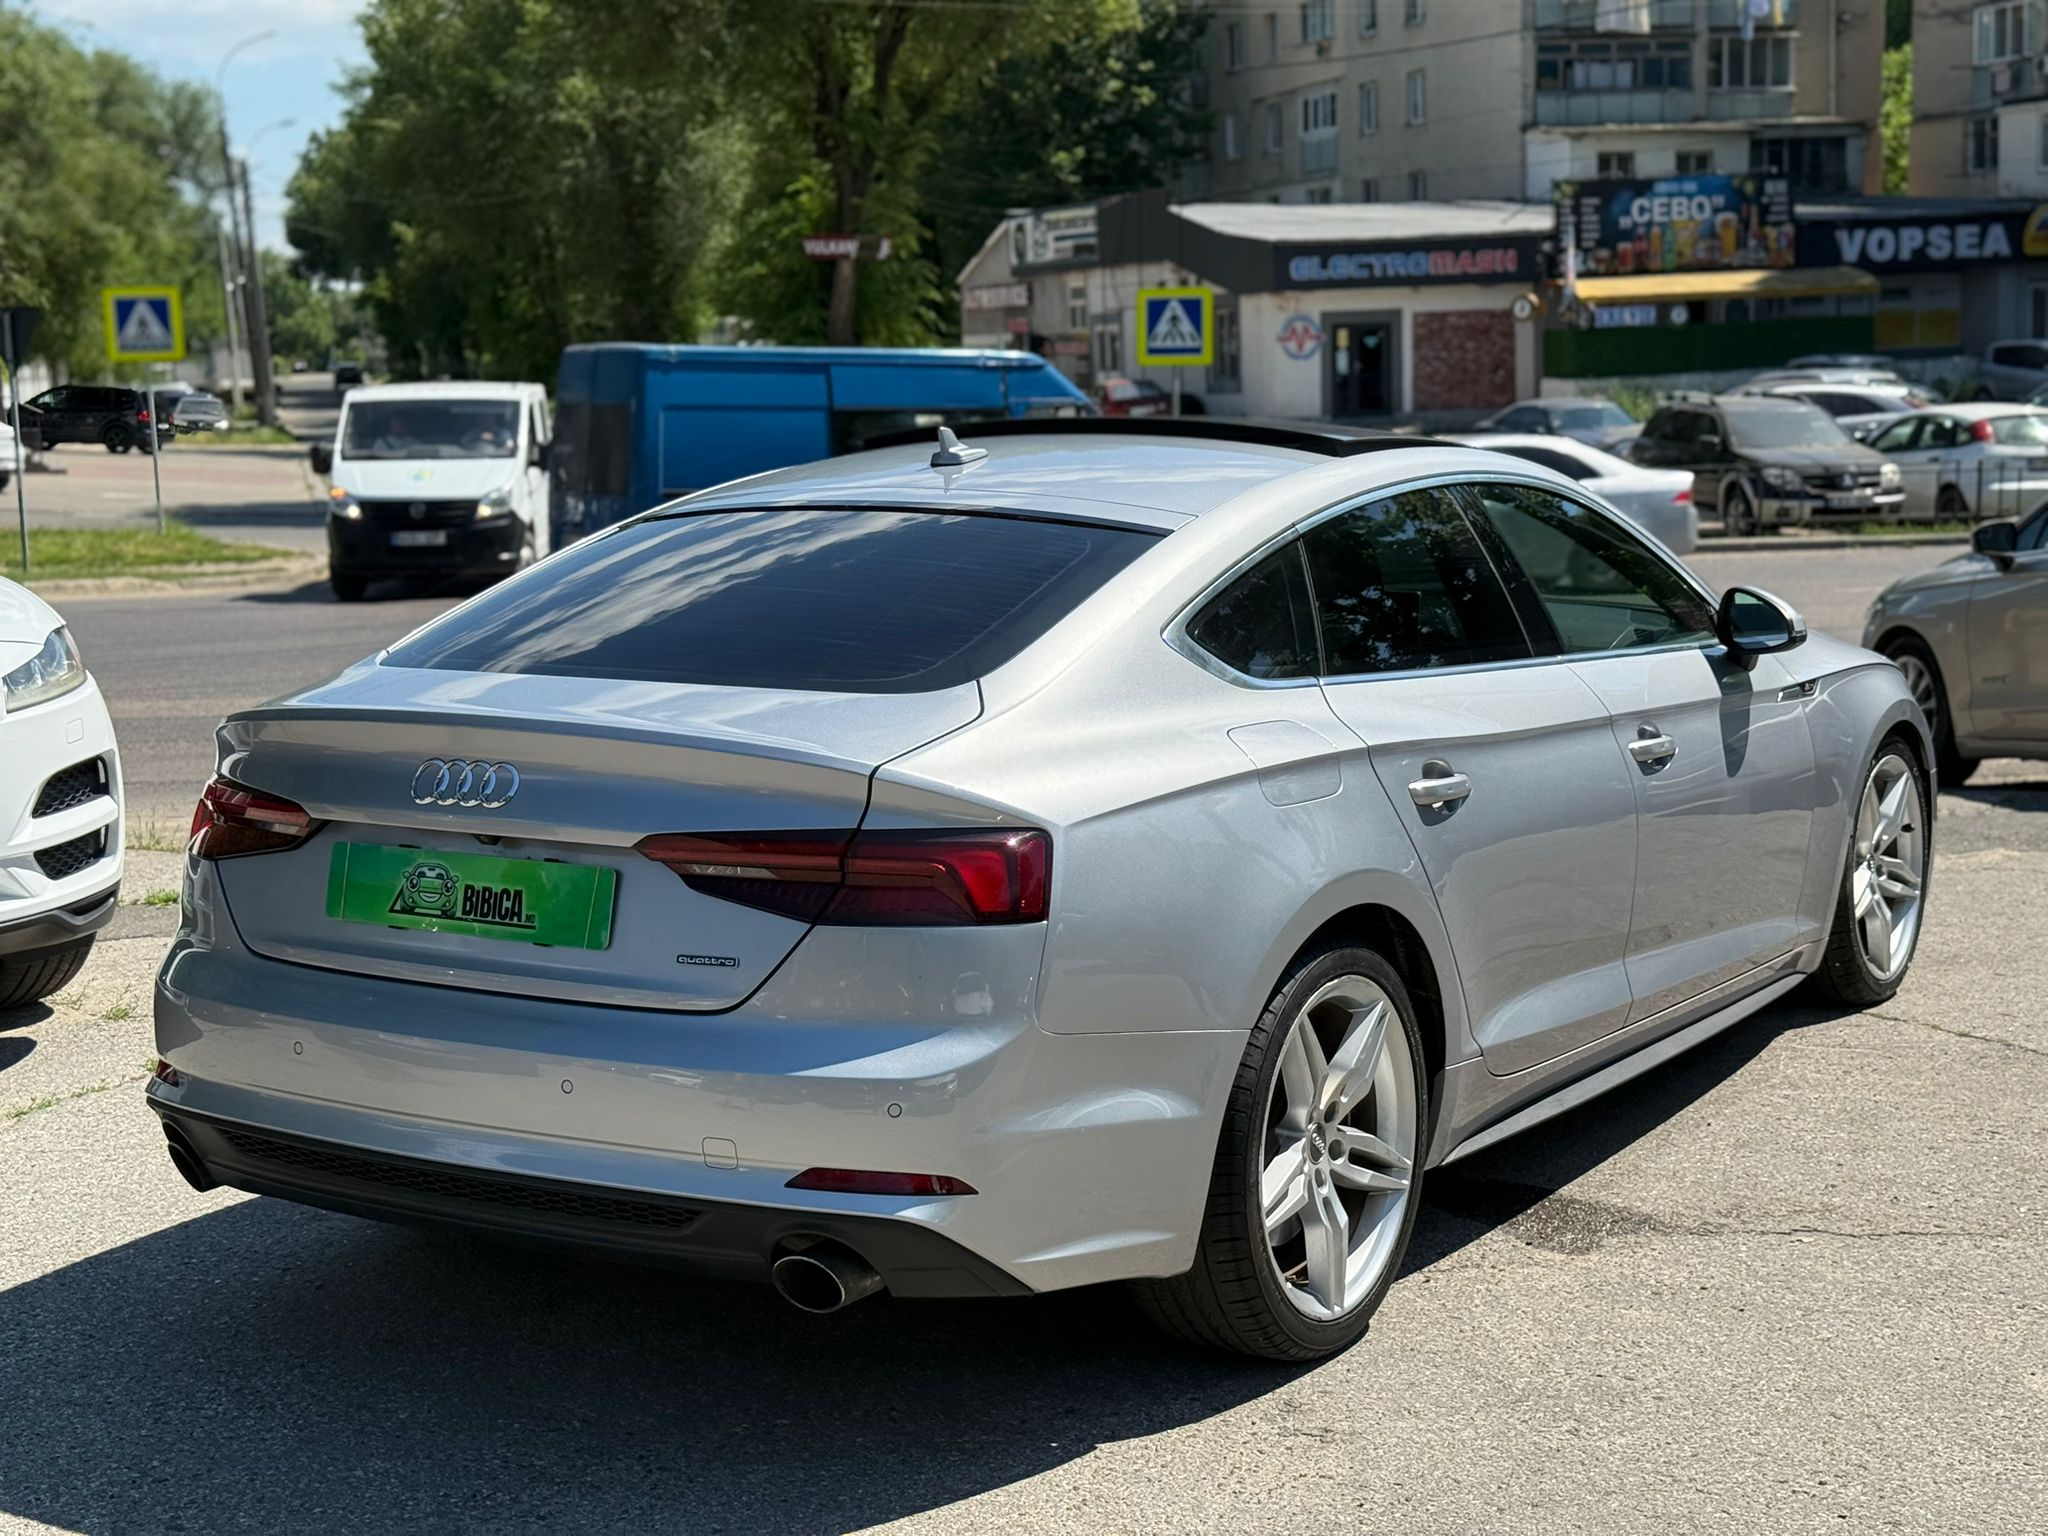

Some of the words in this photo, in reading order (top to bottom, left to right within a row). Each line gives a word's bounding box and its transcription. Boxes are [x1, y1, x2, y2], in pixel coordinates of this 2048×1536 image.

[1835, 222, 2012, 263] VOPSEA
[1289, 249, 1518, 281] ELECTROMASH
[678, 956, 735, 966] quattro
